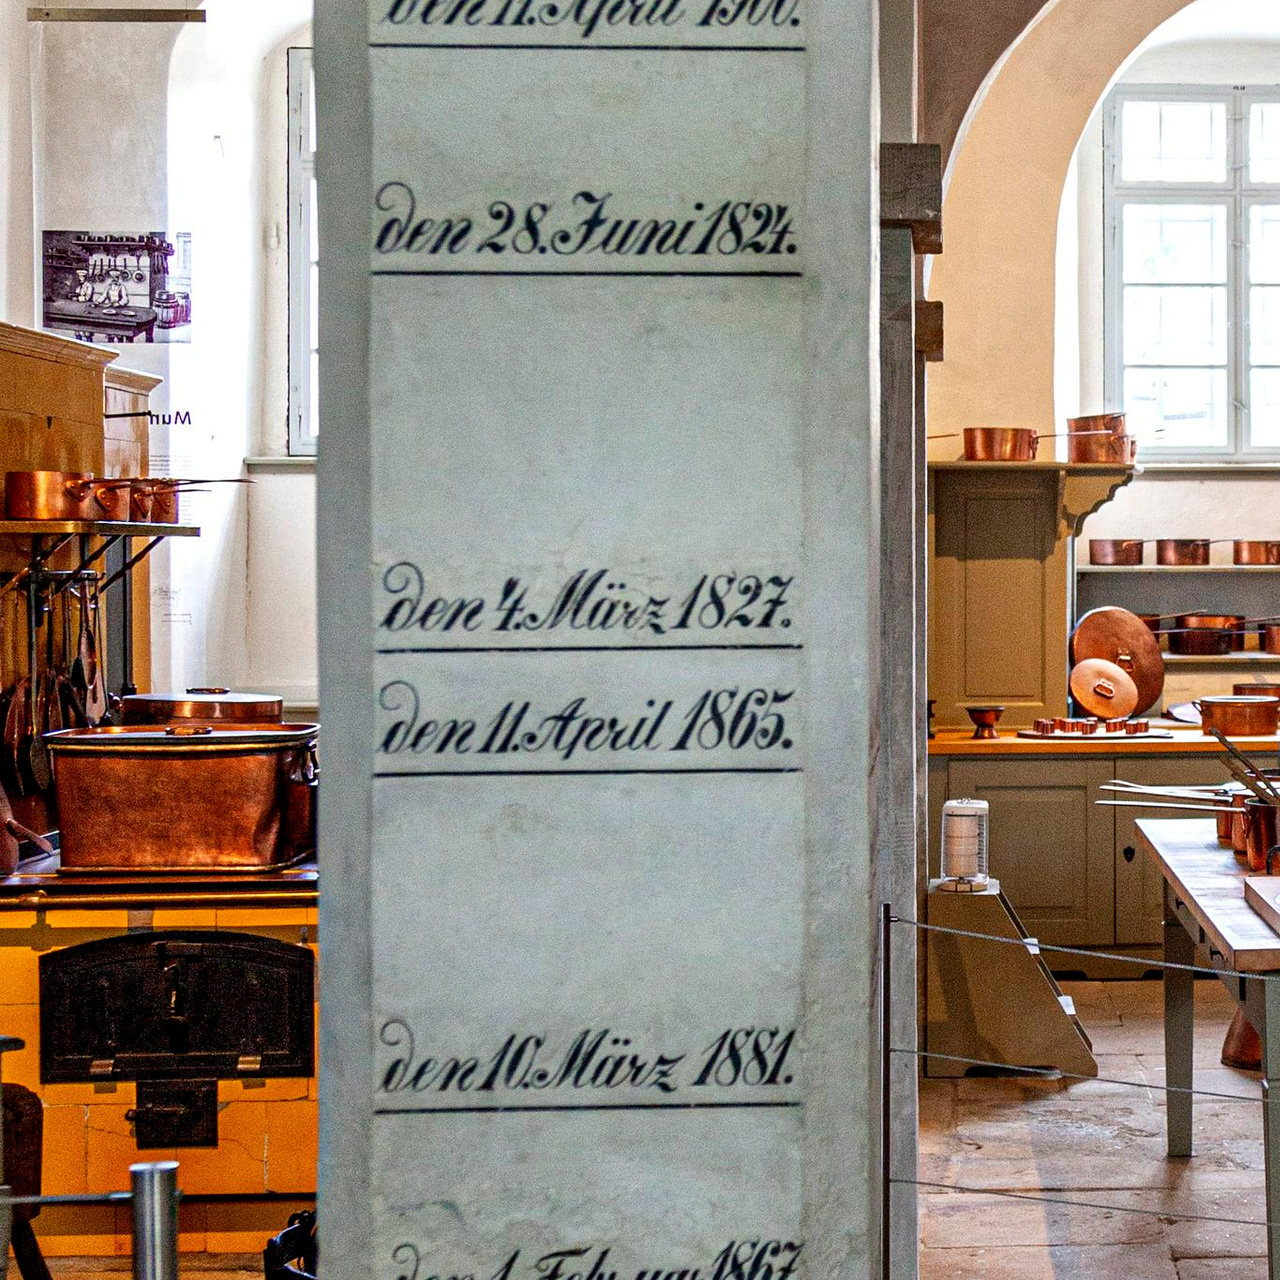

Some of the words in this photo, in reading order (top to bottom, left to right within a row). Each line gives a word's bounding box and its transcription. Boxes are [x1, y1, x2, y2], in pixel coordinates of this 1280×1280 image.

[374, 181, 474, 256] den
[475, 200, 551, 256] 28.
[549, 190, 706, 256] Juni
[690, 200, 799, 256] 1824.
[378, 562, 485, 632] den
[493, 577, 528, 632] 4.
[524, 568, 668, 635] März
[671, 574, 794, 631] 1827.
[378, 680, 477, 755] den
[476, 701, 522, 754] 11.
[519, 696, 674, 761] April
[670, 688, 795, 751] 1865.
[379, 1018, 484, 1095] den
[474, 1033, 538, 1094] 10.
[531, 1028, 686, 1095] März
[690, 1026, 797, 1087] 1881.
